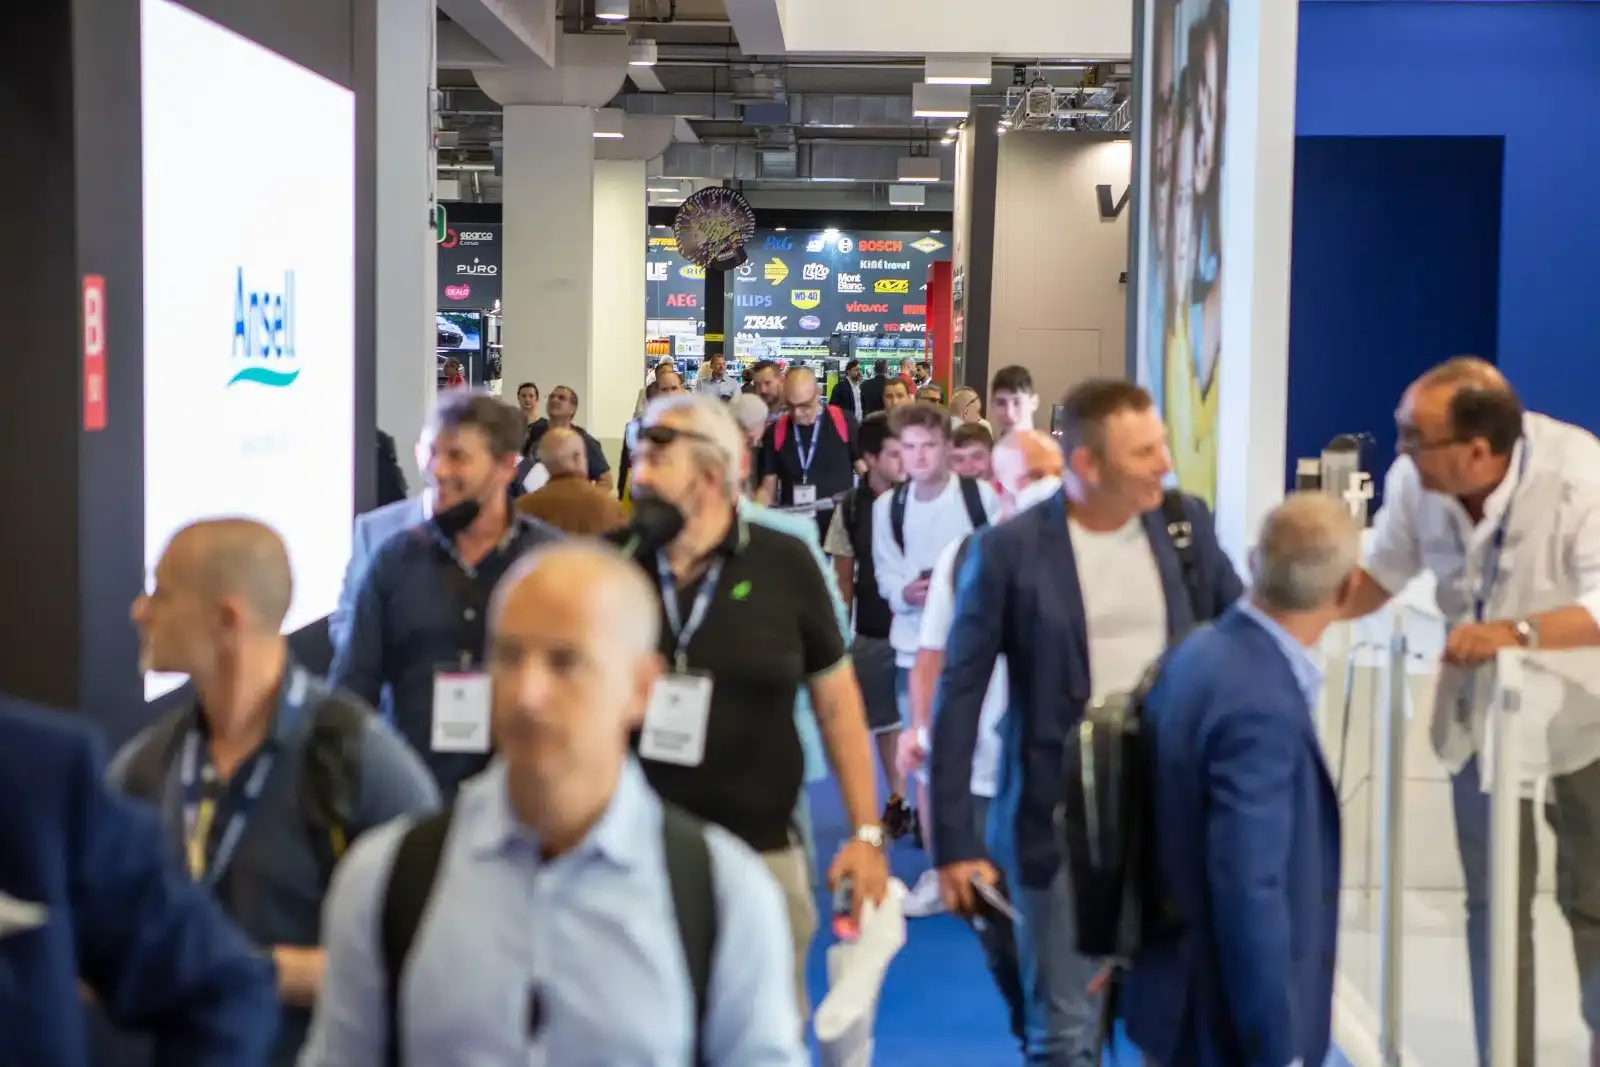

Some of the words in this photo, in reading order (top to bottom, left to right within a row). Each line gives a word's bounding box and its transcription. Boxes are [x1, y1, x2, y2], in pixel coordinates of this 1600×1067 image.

[858, 240, 903, 252] BOSCH
[457, 264, 497, 274] PURO
[884, 261, 910, 270] travel
[838, 273, 861, 282] Mont
[666, 294, 697, 307] AEG
[794, 292, 818, 301] WD-40
[743, 315, 787, 330] TRAK
[835, 322, 876, 332] AdBlue
